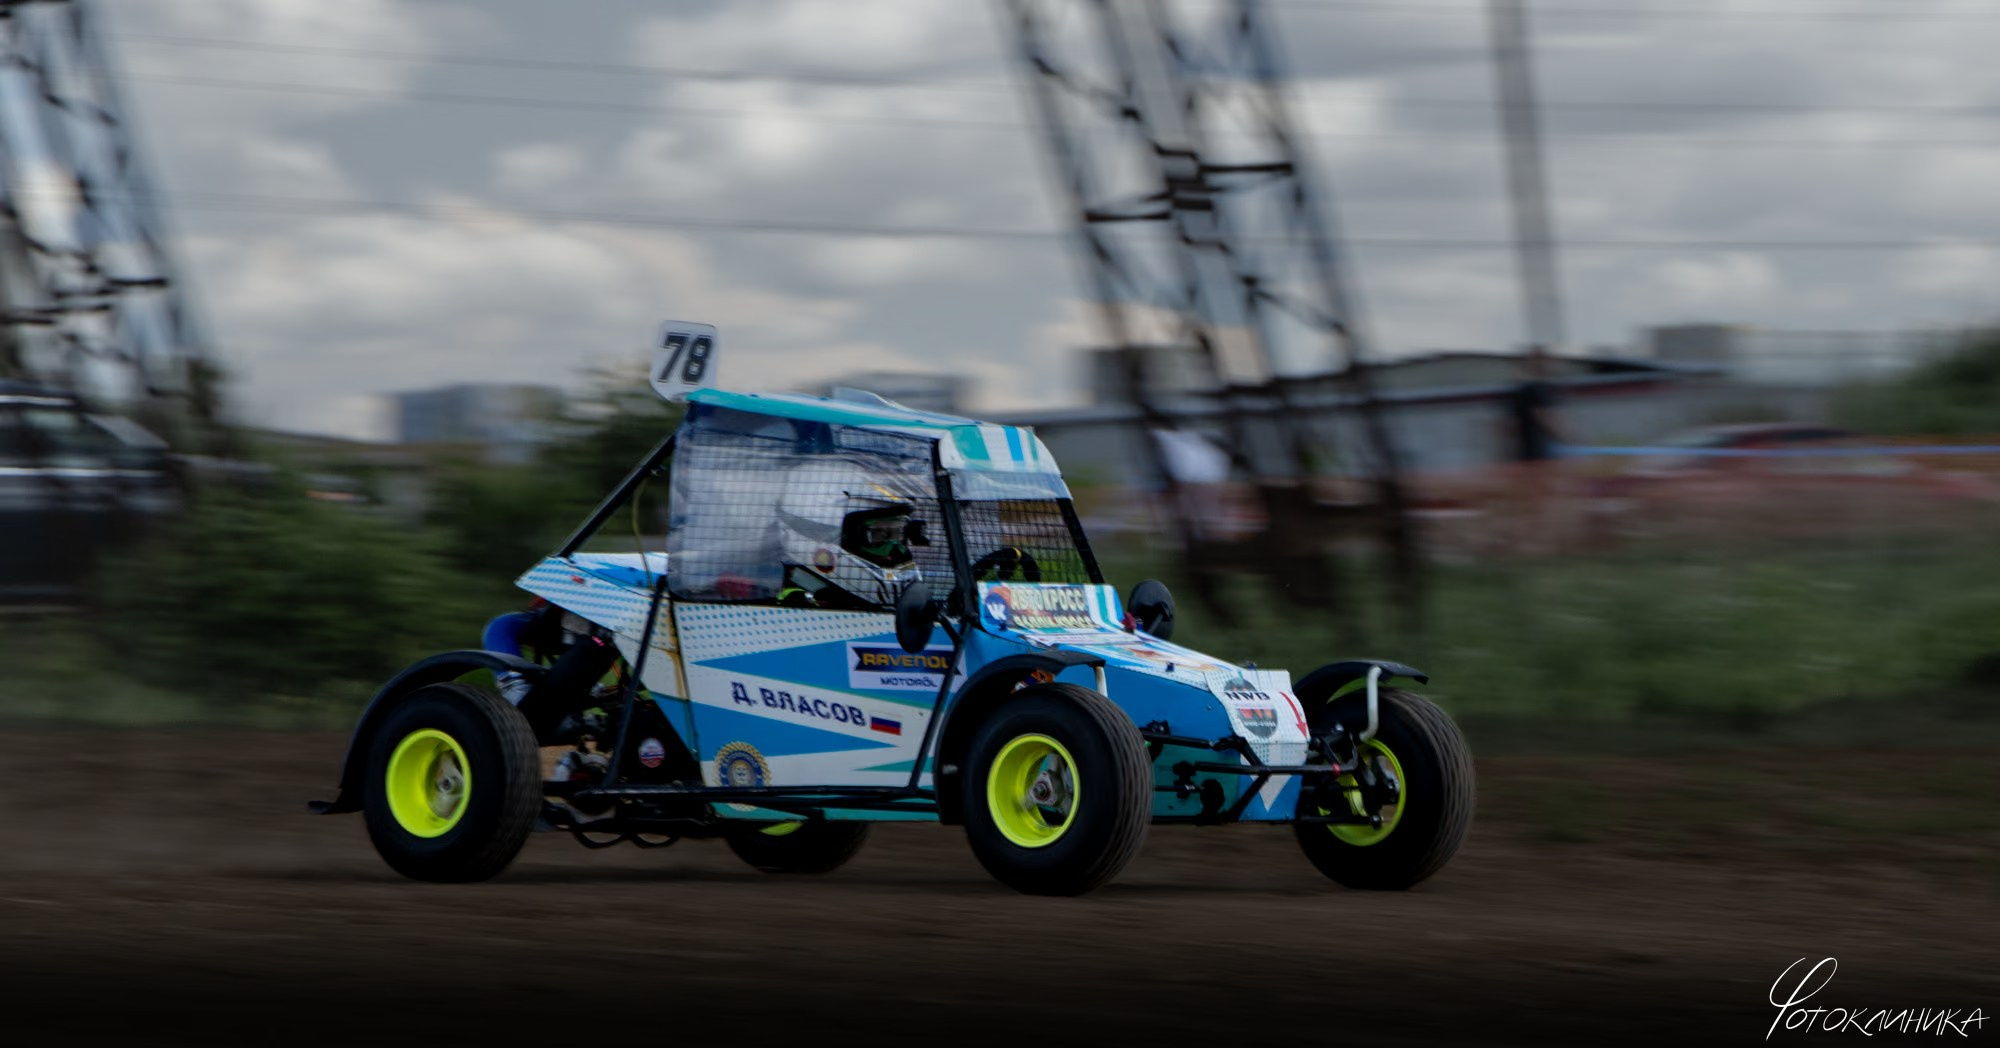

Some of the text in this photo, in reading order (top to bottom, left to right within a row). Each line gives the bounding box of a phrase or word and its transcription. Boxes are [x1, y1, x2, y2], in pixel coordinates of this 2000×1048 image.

[657, 332, 713, 385] 78
[862, 652, 950, 670] RAVENOL
[731, 681, 867, 728] Д. ВЛАСОВ
